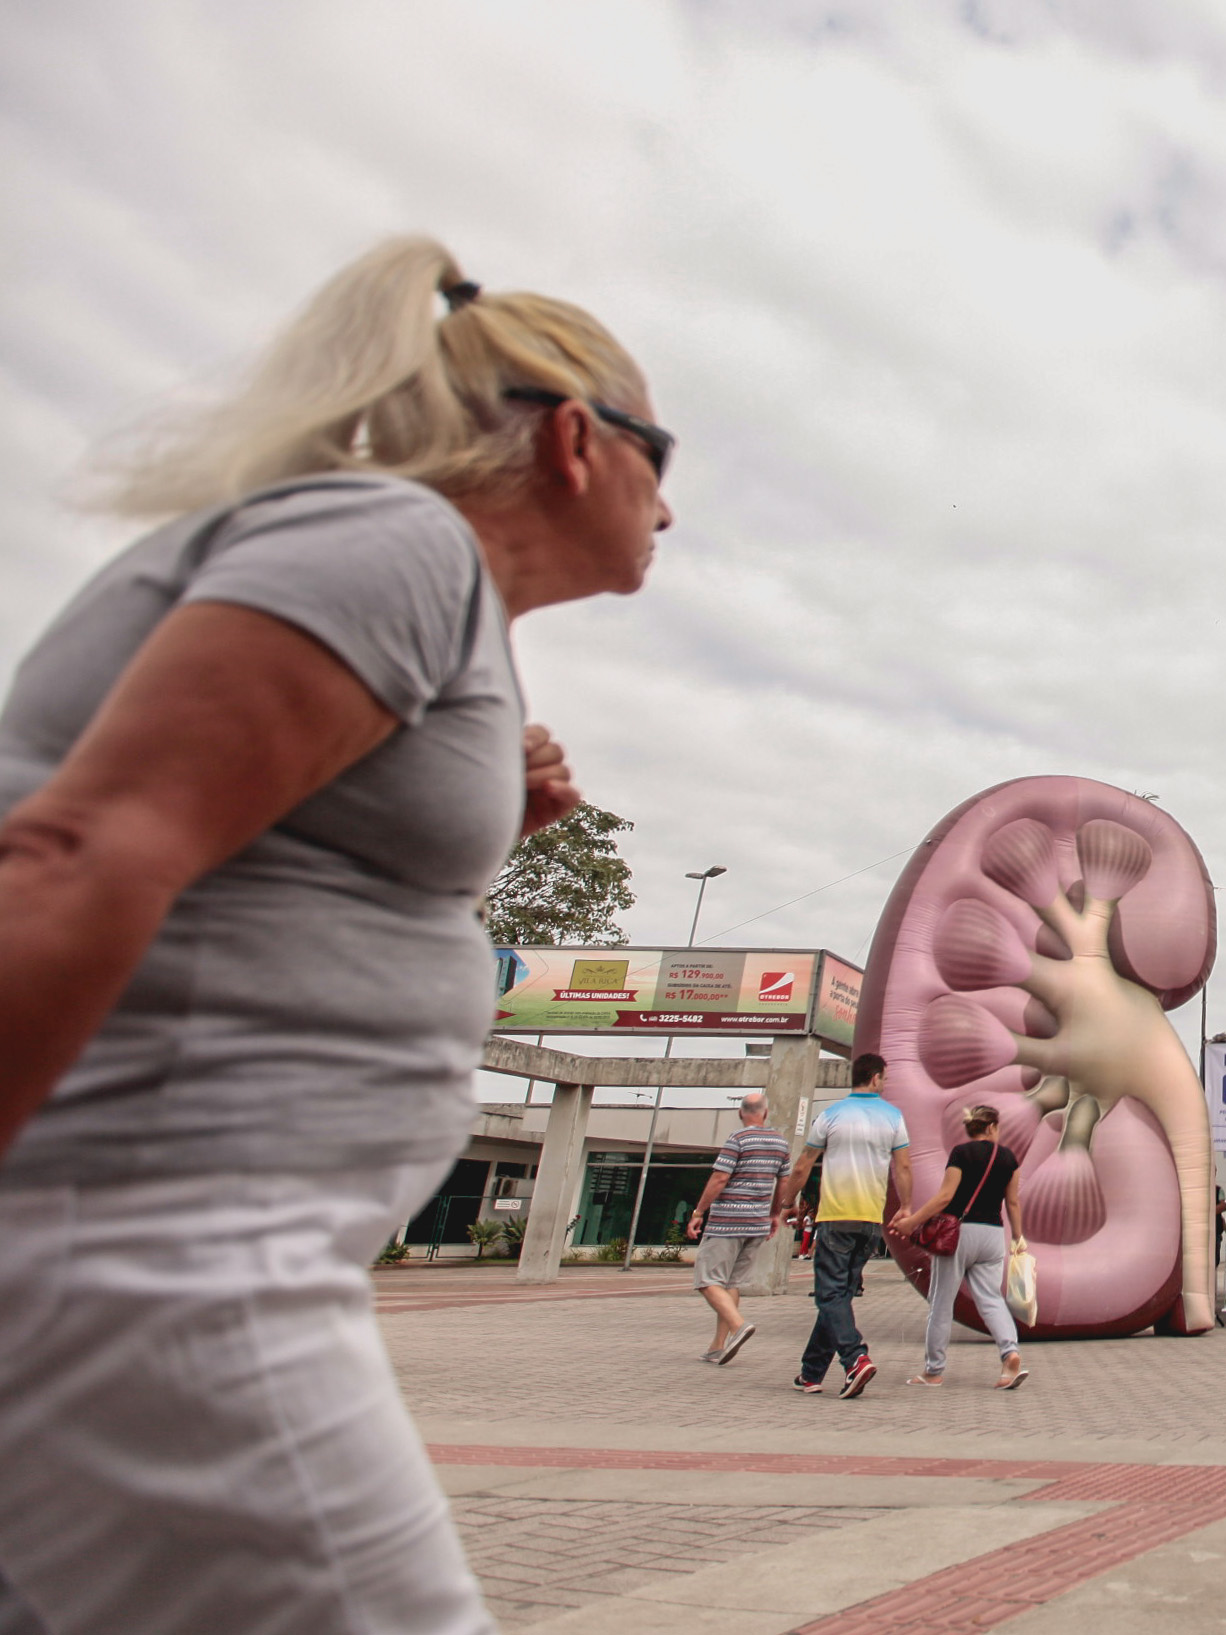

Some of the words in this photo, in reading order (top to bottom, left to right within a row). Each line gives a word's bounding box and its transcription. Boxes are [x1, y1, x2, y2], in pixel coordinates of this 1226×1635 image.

[682, 970, 724, 980] 129.900,00
[560, 991, 590, 999] ÚLTIMAS
[659, 1014, 703, 1022] 3225-5482
[721, 1016, 790, 1024] www.otrebor.com.br
